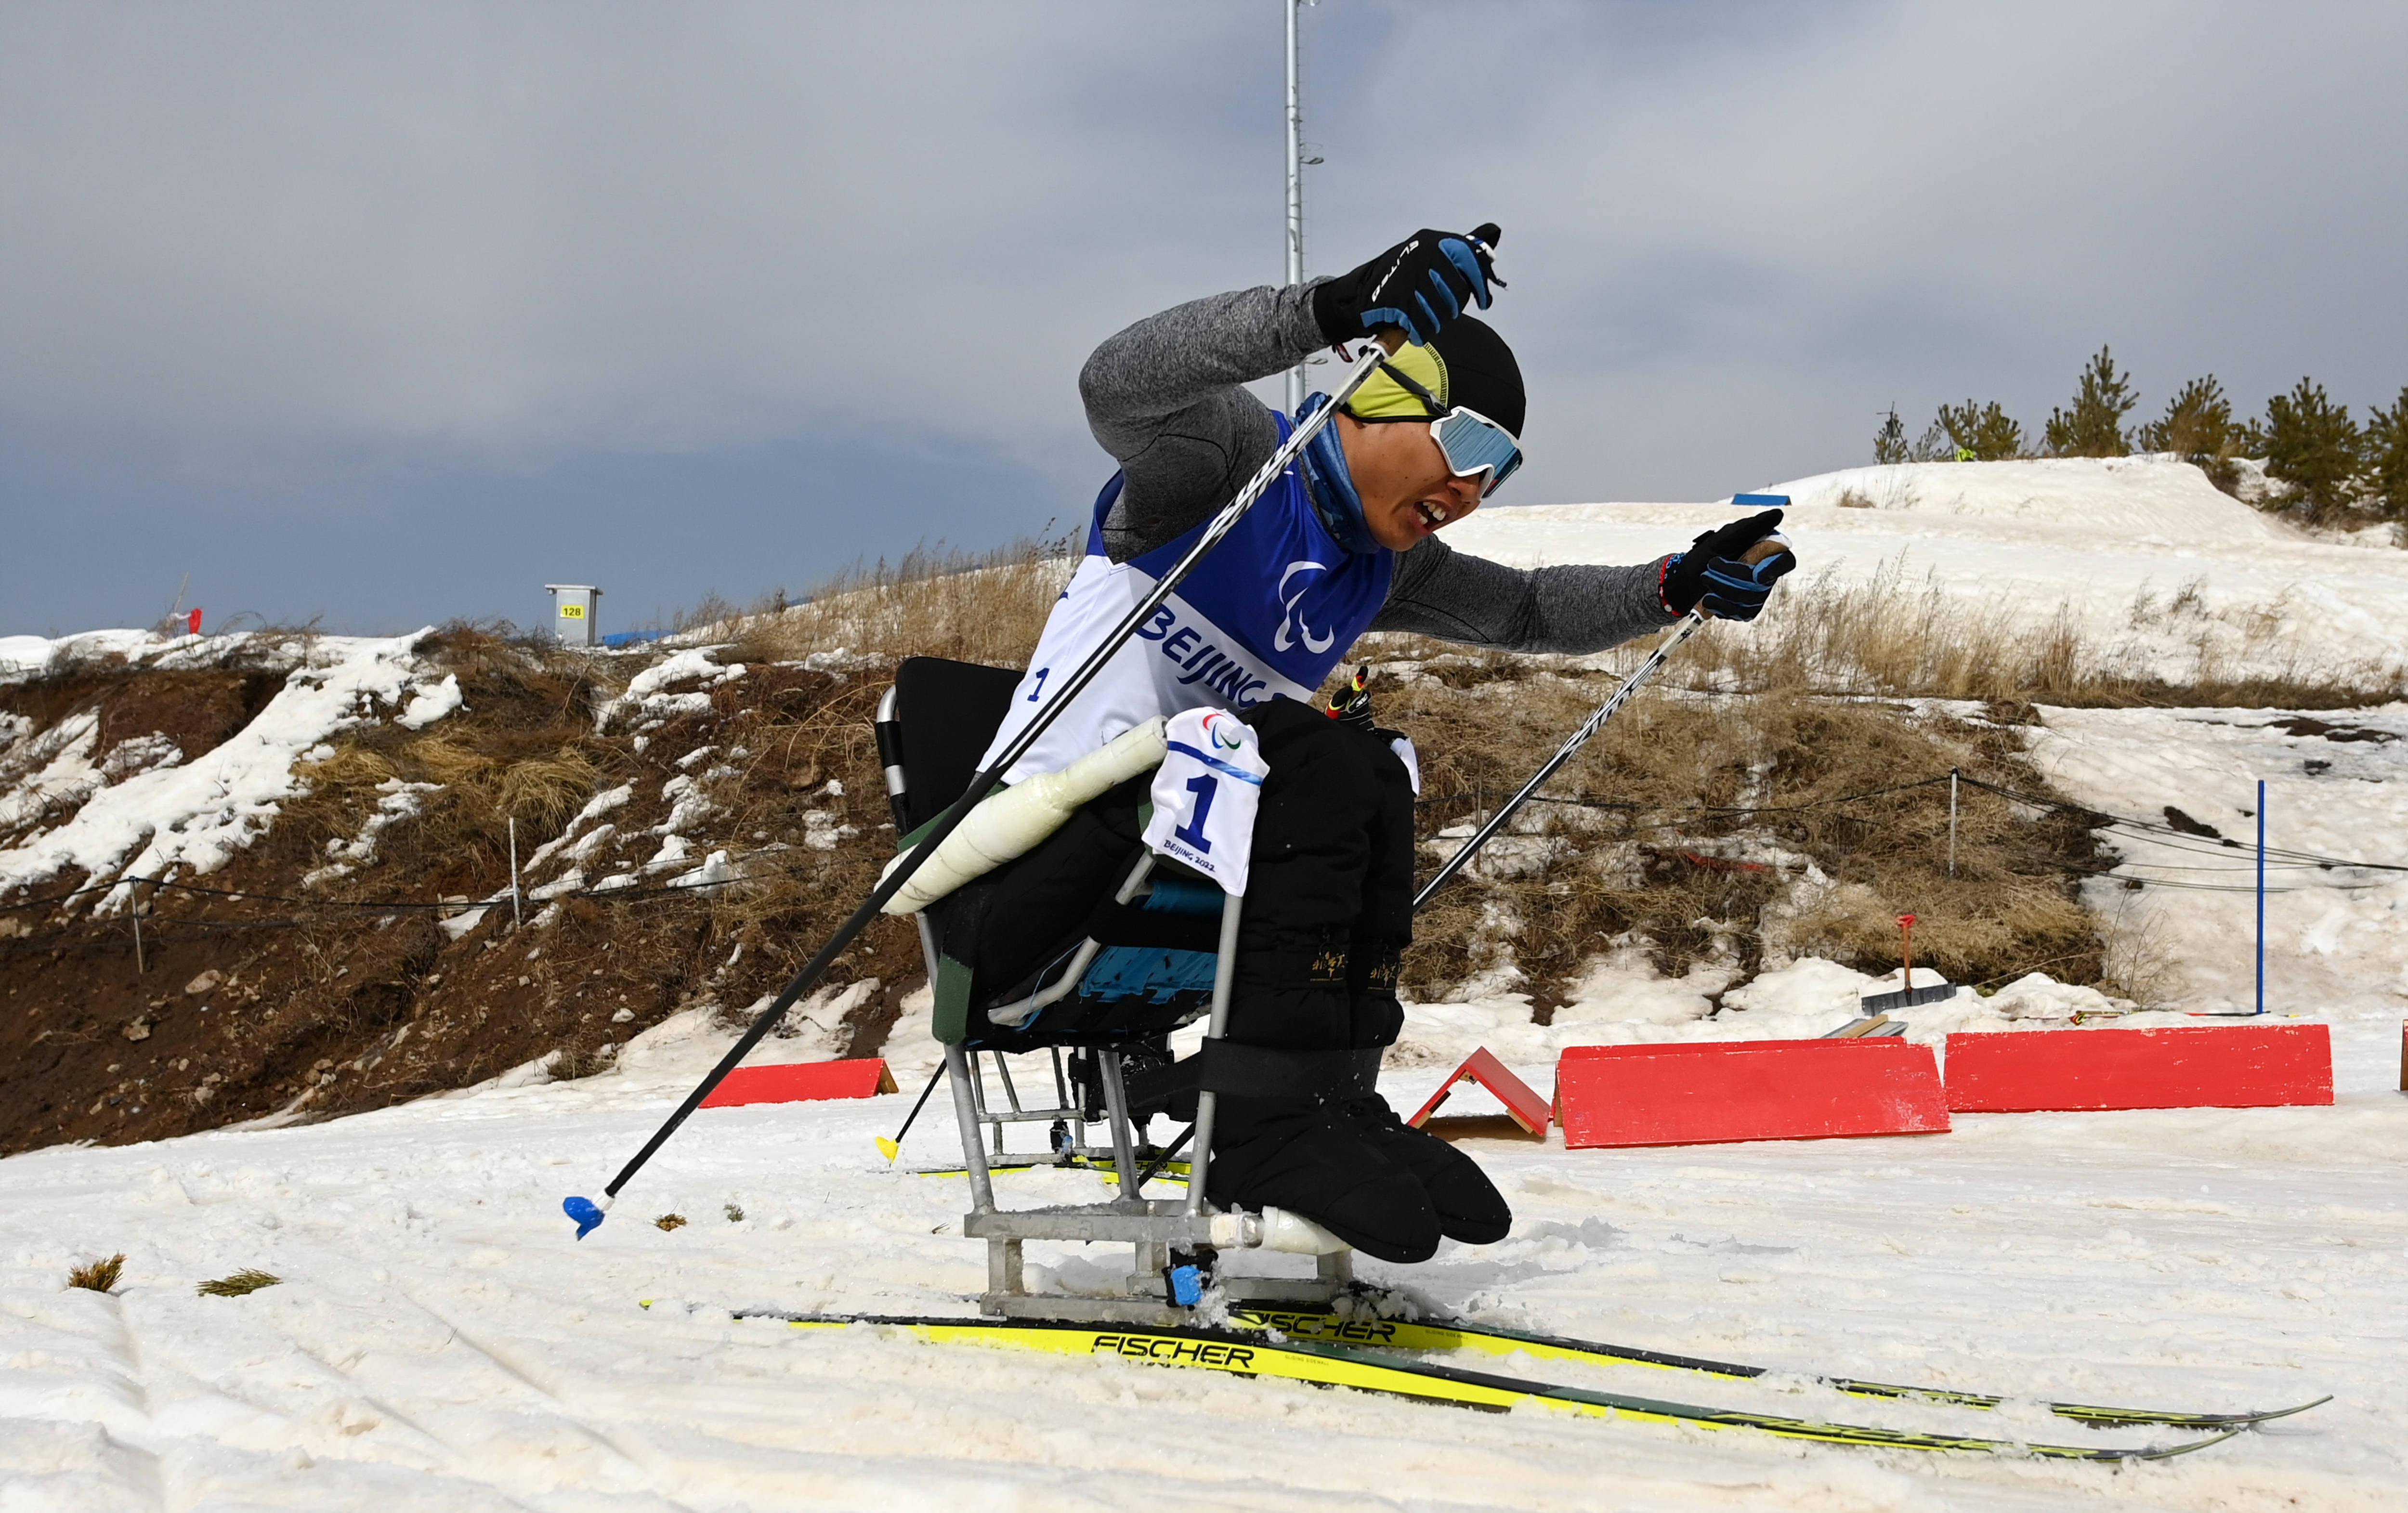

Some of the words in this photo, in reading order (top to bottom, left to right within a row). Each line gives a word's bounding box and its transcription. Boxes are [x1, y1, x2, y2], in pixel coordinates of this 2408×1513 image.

[1211, 410, 1330, 548] SWIX
[563, 608, 581, 616] 128
[1135, 602, 1267, 708] BEIJING
[1027, 667, 1050, 702] 1
[1564, 659, 1658, 763] SWIX
[1174, 773, 1218, 855] 1
[1164, 839, 1194, 861] BEIJING
[1195, 856, 1216, 873] 2022
[1091, 1335, 1254, 1369] FISCHER
